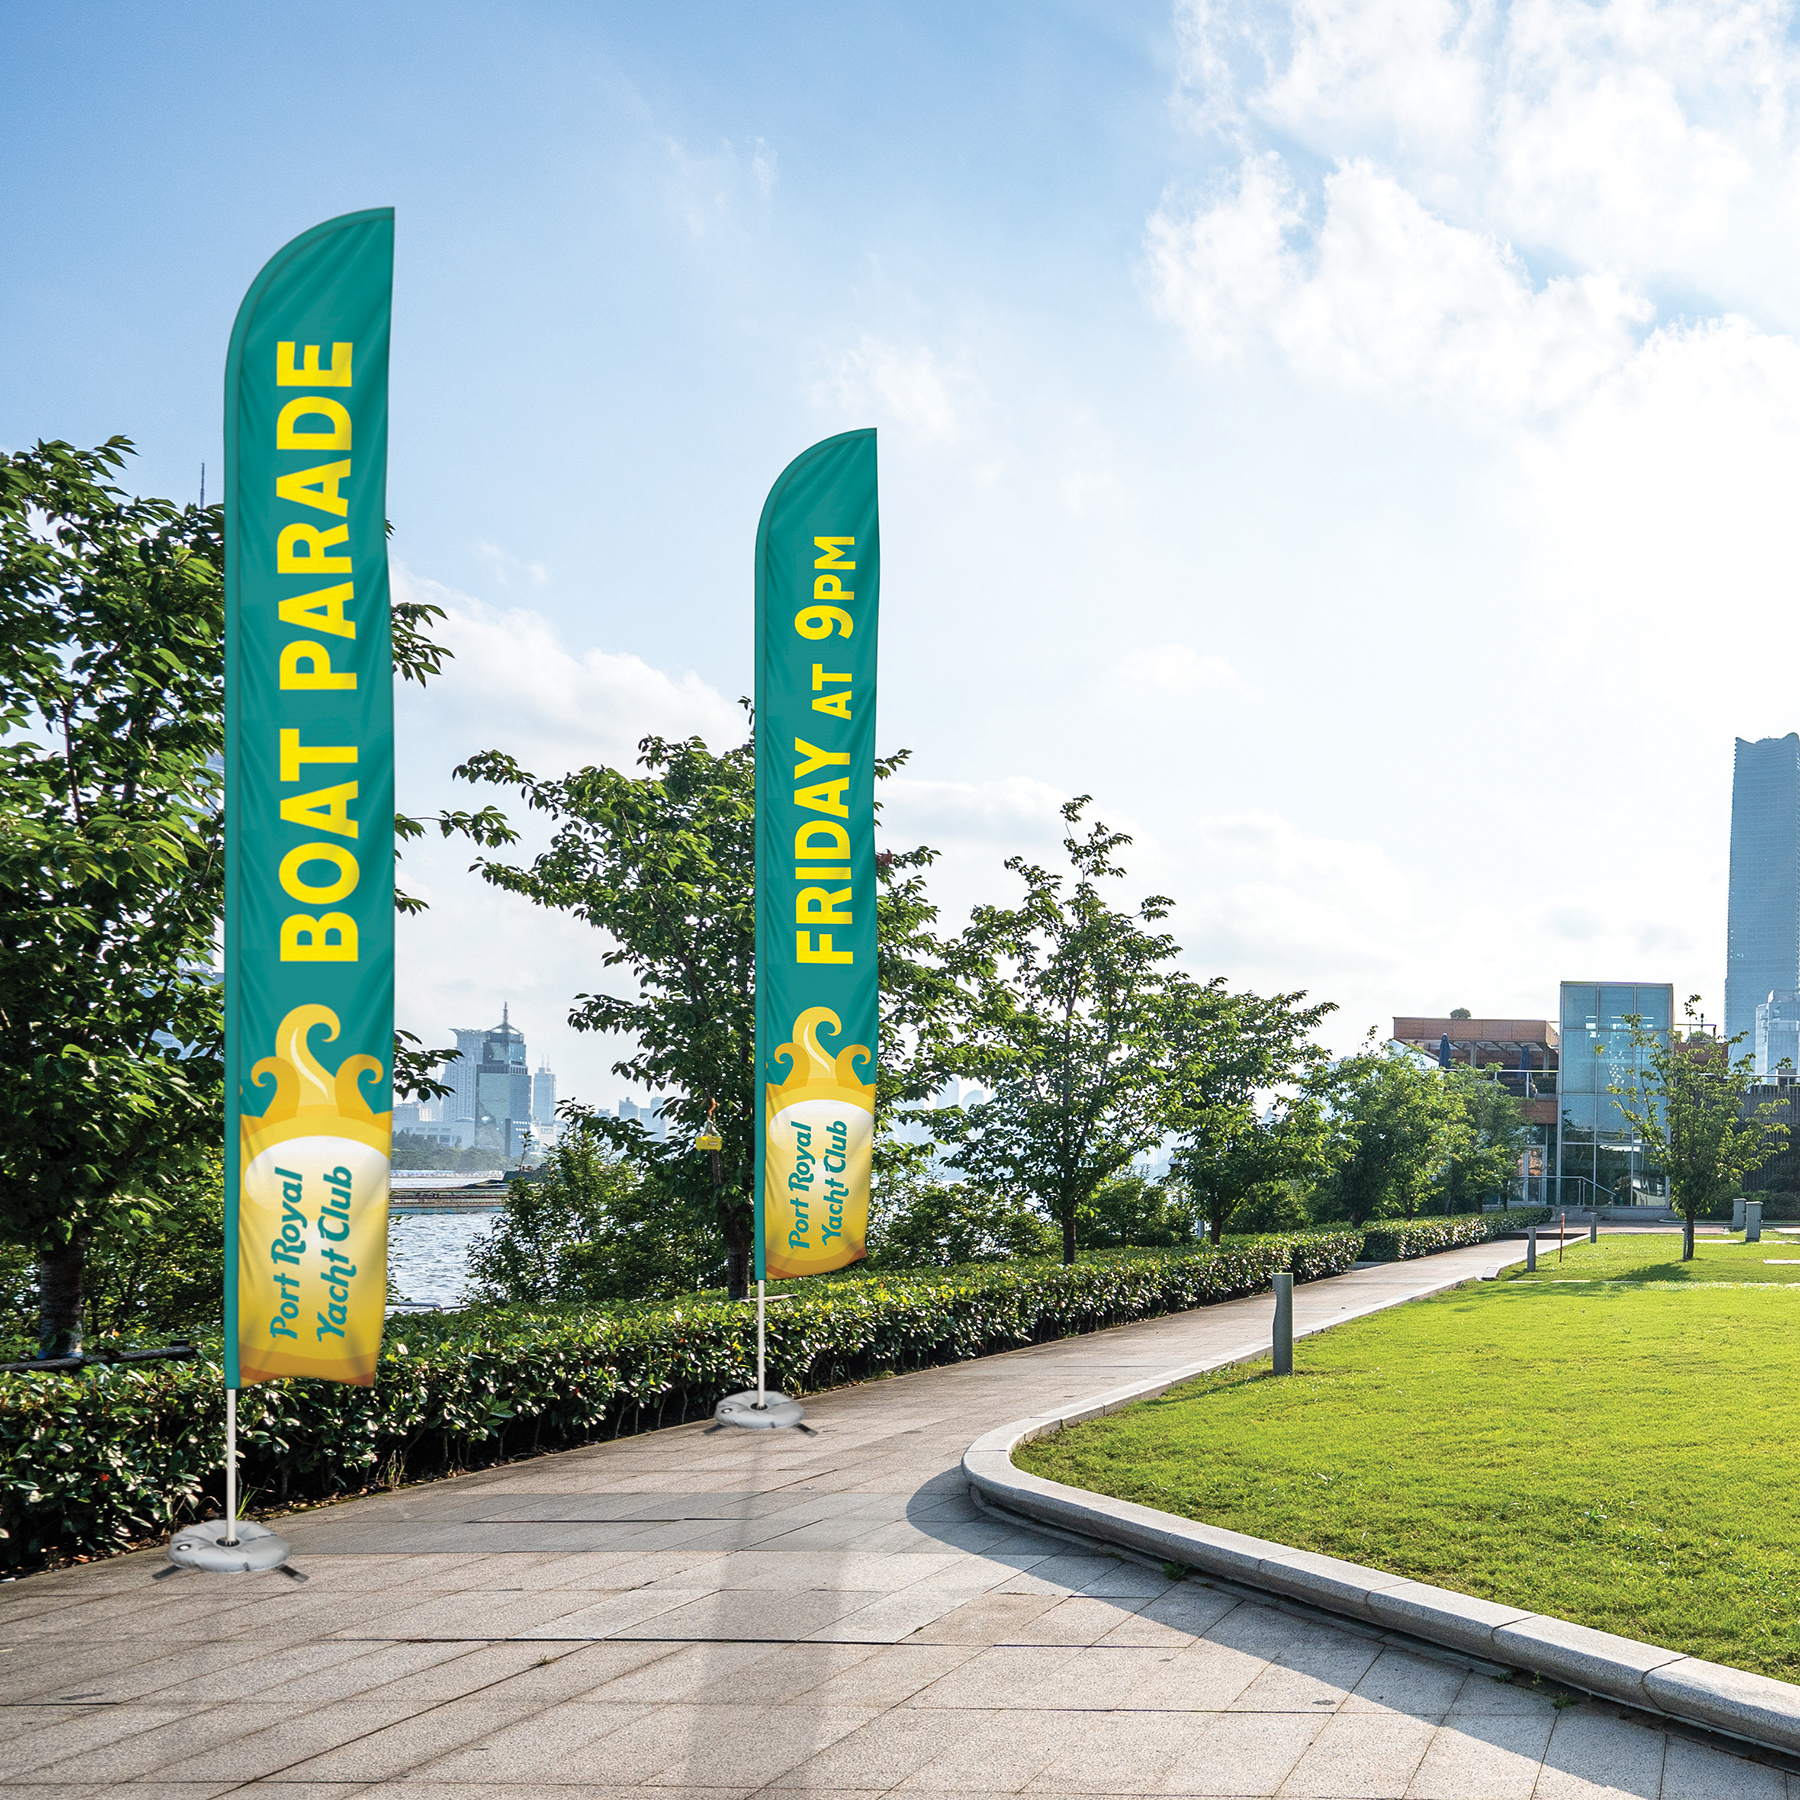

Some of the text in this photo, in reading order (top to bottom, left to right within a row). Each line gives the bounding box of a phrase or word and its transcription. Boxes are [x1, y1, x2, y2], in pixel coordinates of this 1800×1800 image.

[275, 341, 359, 962] BOAT PARADE
[794, 536, 856, 965] FRIDAY AT 9PM
[269, 1166, 308, 1340] Port Royal
[316, 1165, 358, 1343] Yacht Club
[788, 1120, 816, 1250] Port Royal
[821, 1119, 850, 1246] Yacht Club
